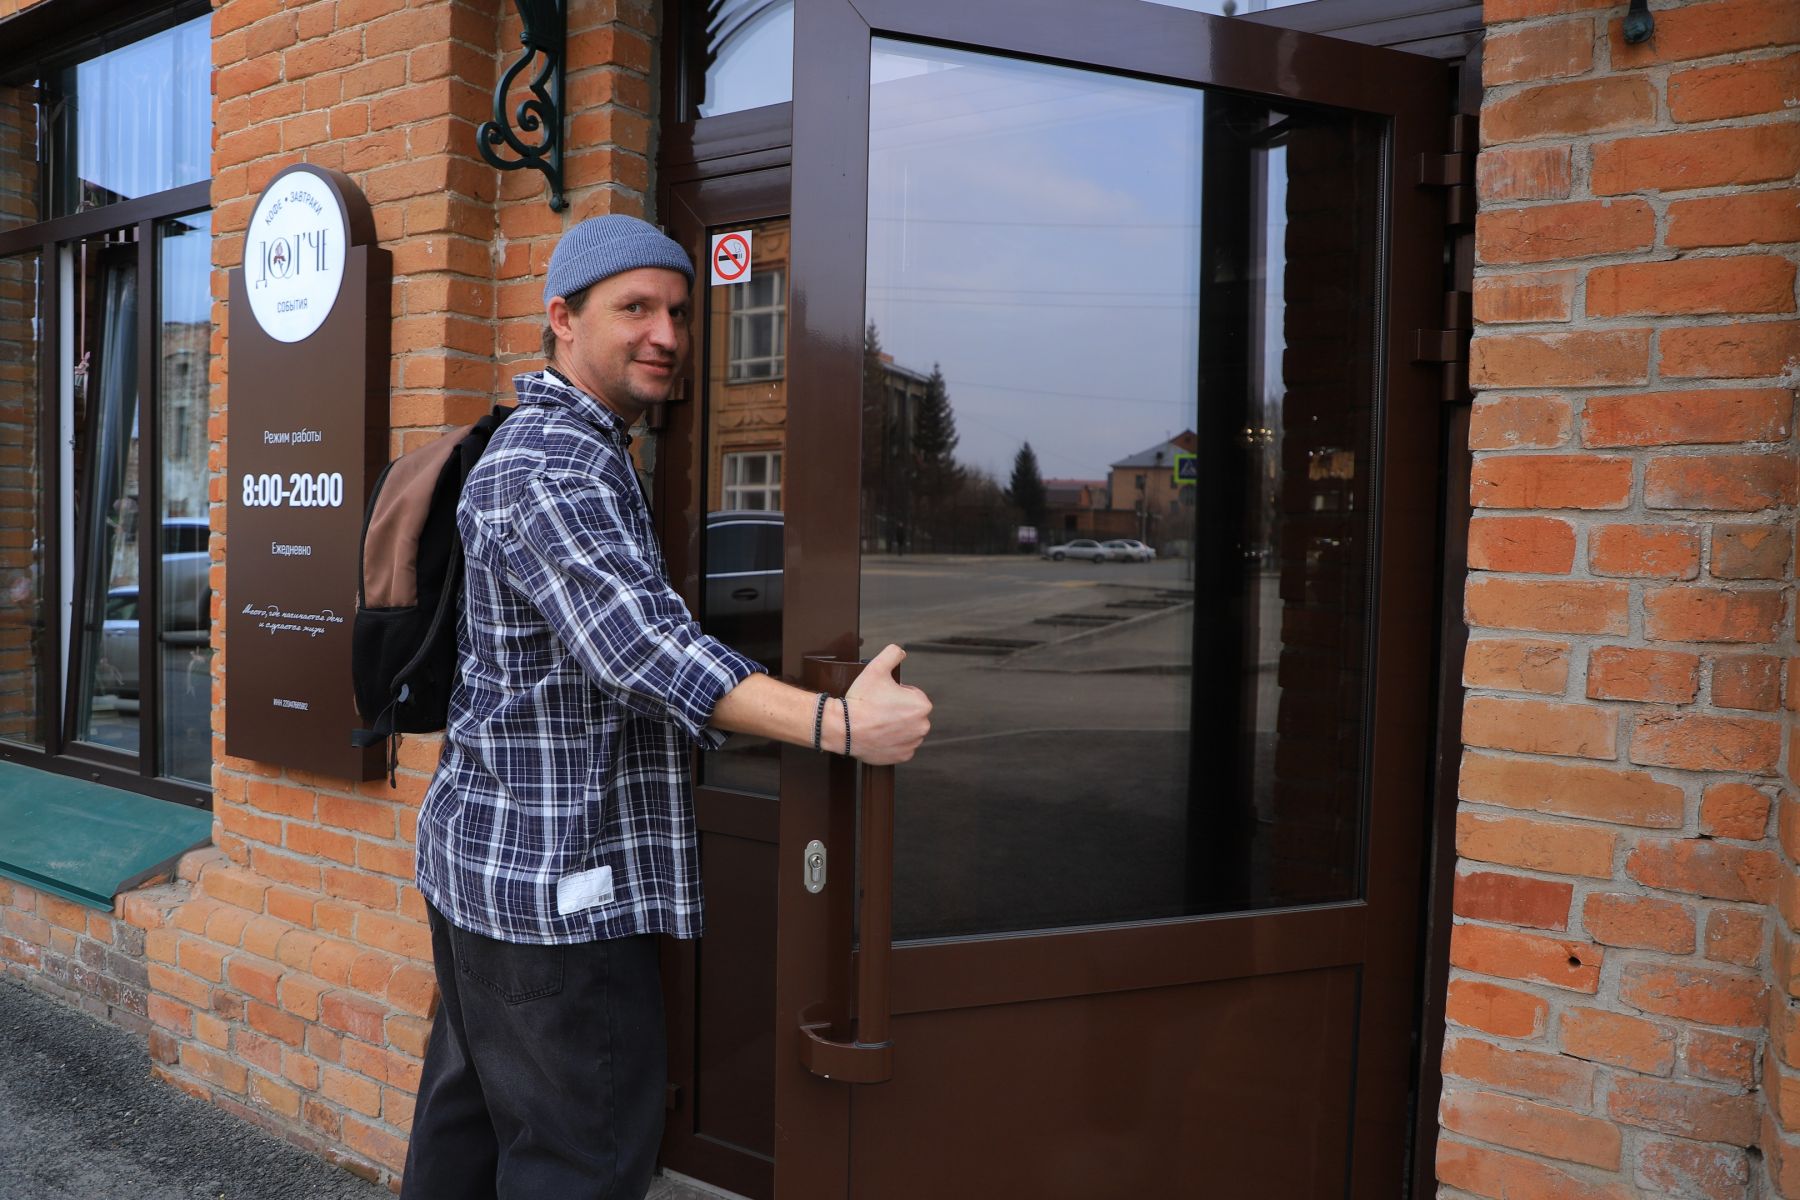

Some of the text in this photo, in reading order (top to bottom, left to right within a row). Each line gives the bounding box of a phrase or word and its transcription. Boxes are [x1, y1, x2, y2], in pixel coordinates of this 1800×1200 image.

[265, 191, 323, 226] КОФЕ ЗАВТРАКИ
[277, 298, 308, 313] СОБЫТИЯ
[264, 428, 322, 445] Режим работы
[242, 472, 343, 507] 8:00-20:00
[271, 541, 312, 556] Ежедневно
